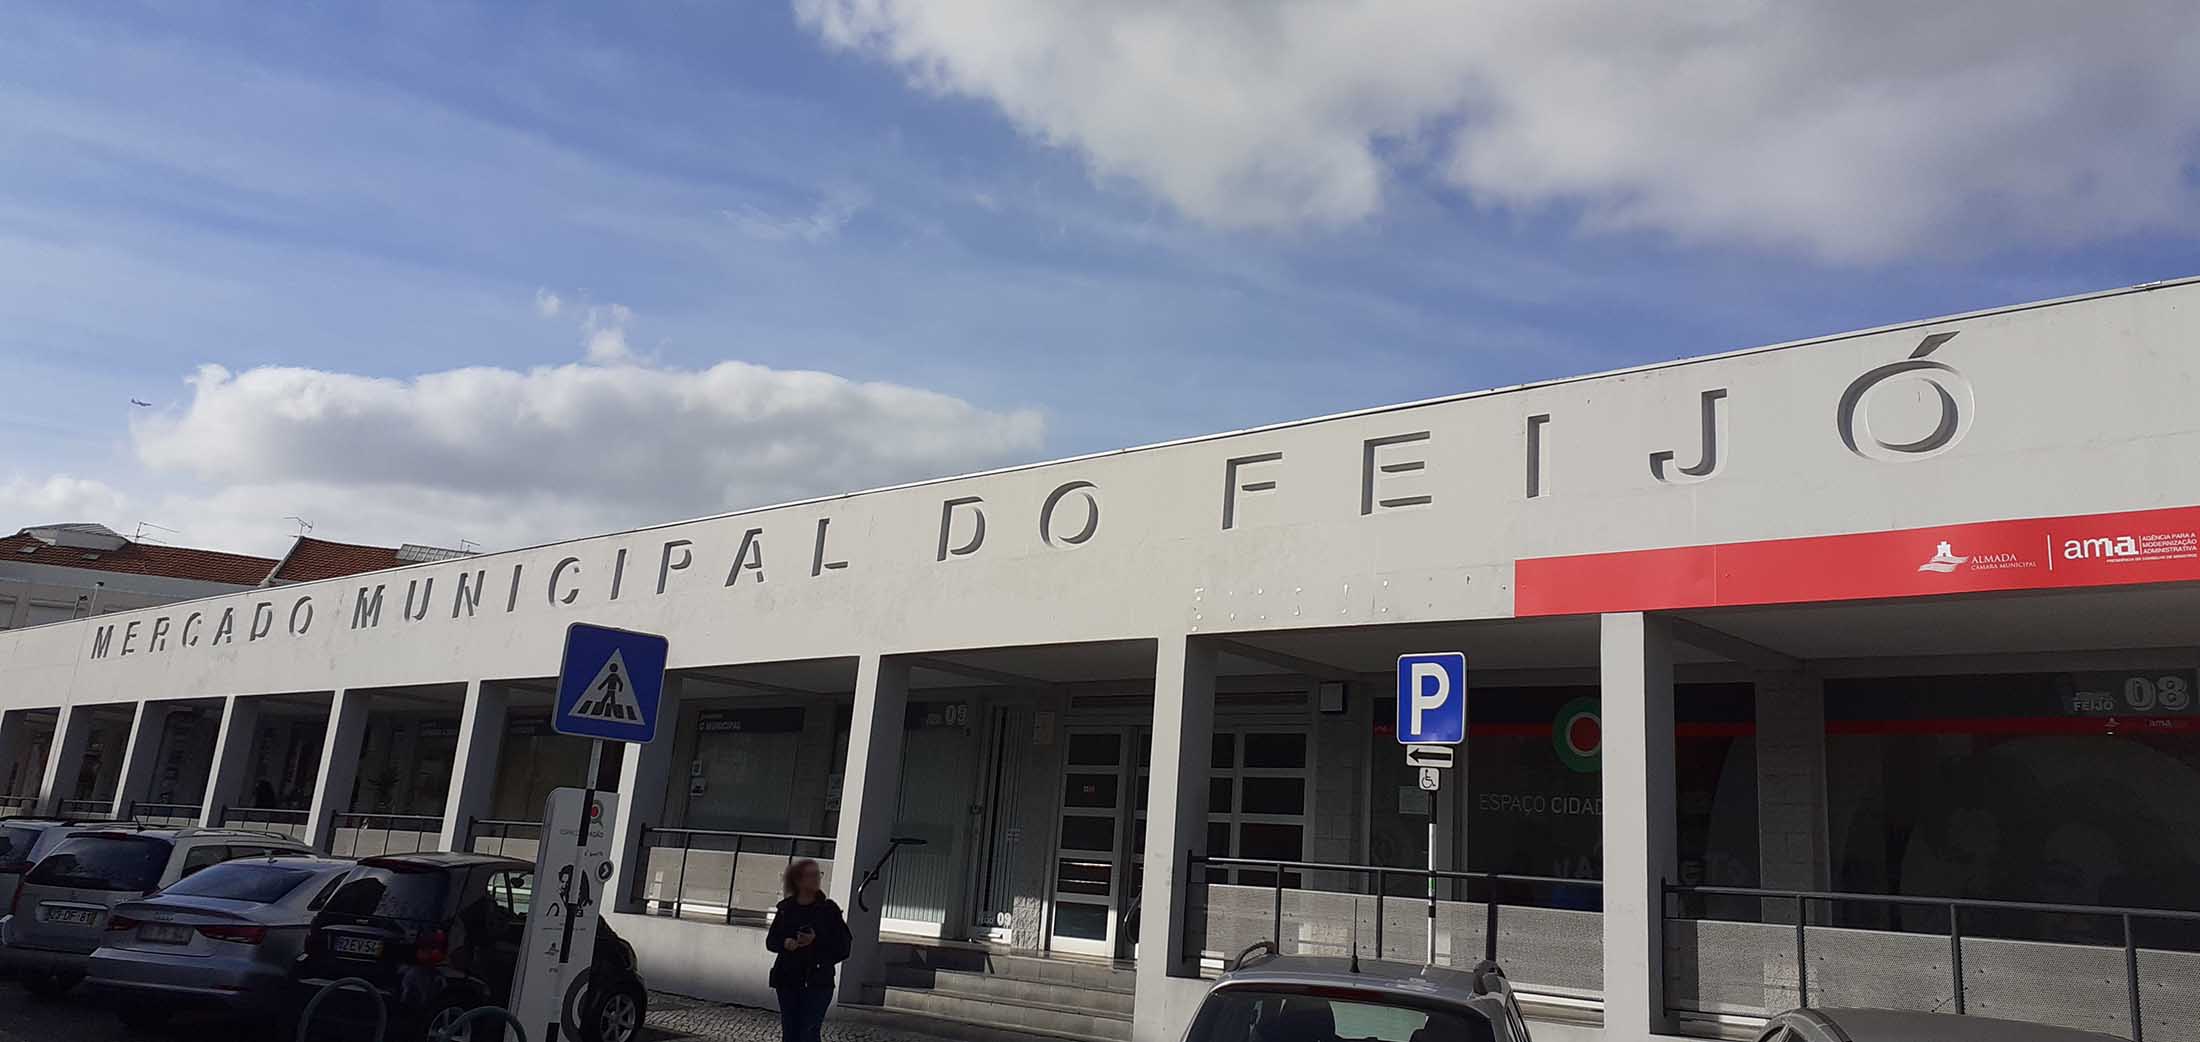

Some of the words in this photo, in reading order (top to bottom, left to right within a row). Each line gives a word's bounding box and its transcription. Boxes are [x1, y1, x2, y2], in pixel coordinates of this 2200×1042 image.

[90, 595, 314, 660] MERCADO
[351, 517, 850, 630] MUNICIPAL
[936, 480, 1099, 562] DO
[1221, 331, 1976, 530] FEIJÓ
[2063, 536, 2139, 560] ama
[2143, 545, 2197, 554] ADMINISTRATIVA
[1971, 553, 2017, 564] ALMADA
[1999, 561, 2037, 569] MUNICIPAL
[1410, 662, 1450, 736] P
[2124, 676, 2190, 711] 08
[1479, 794, 1546, 814] ESPAÇO
[997, 912, 1012, 927] 09
